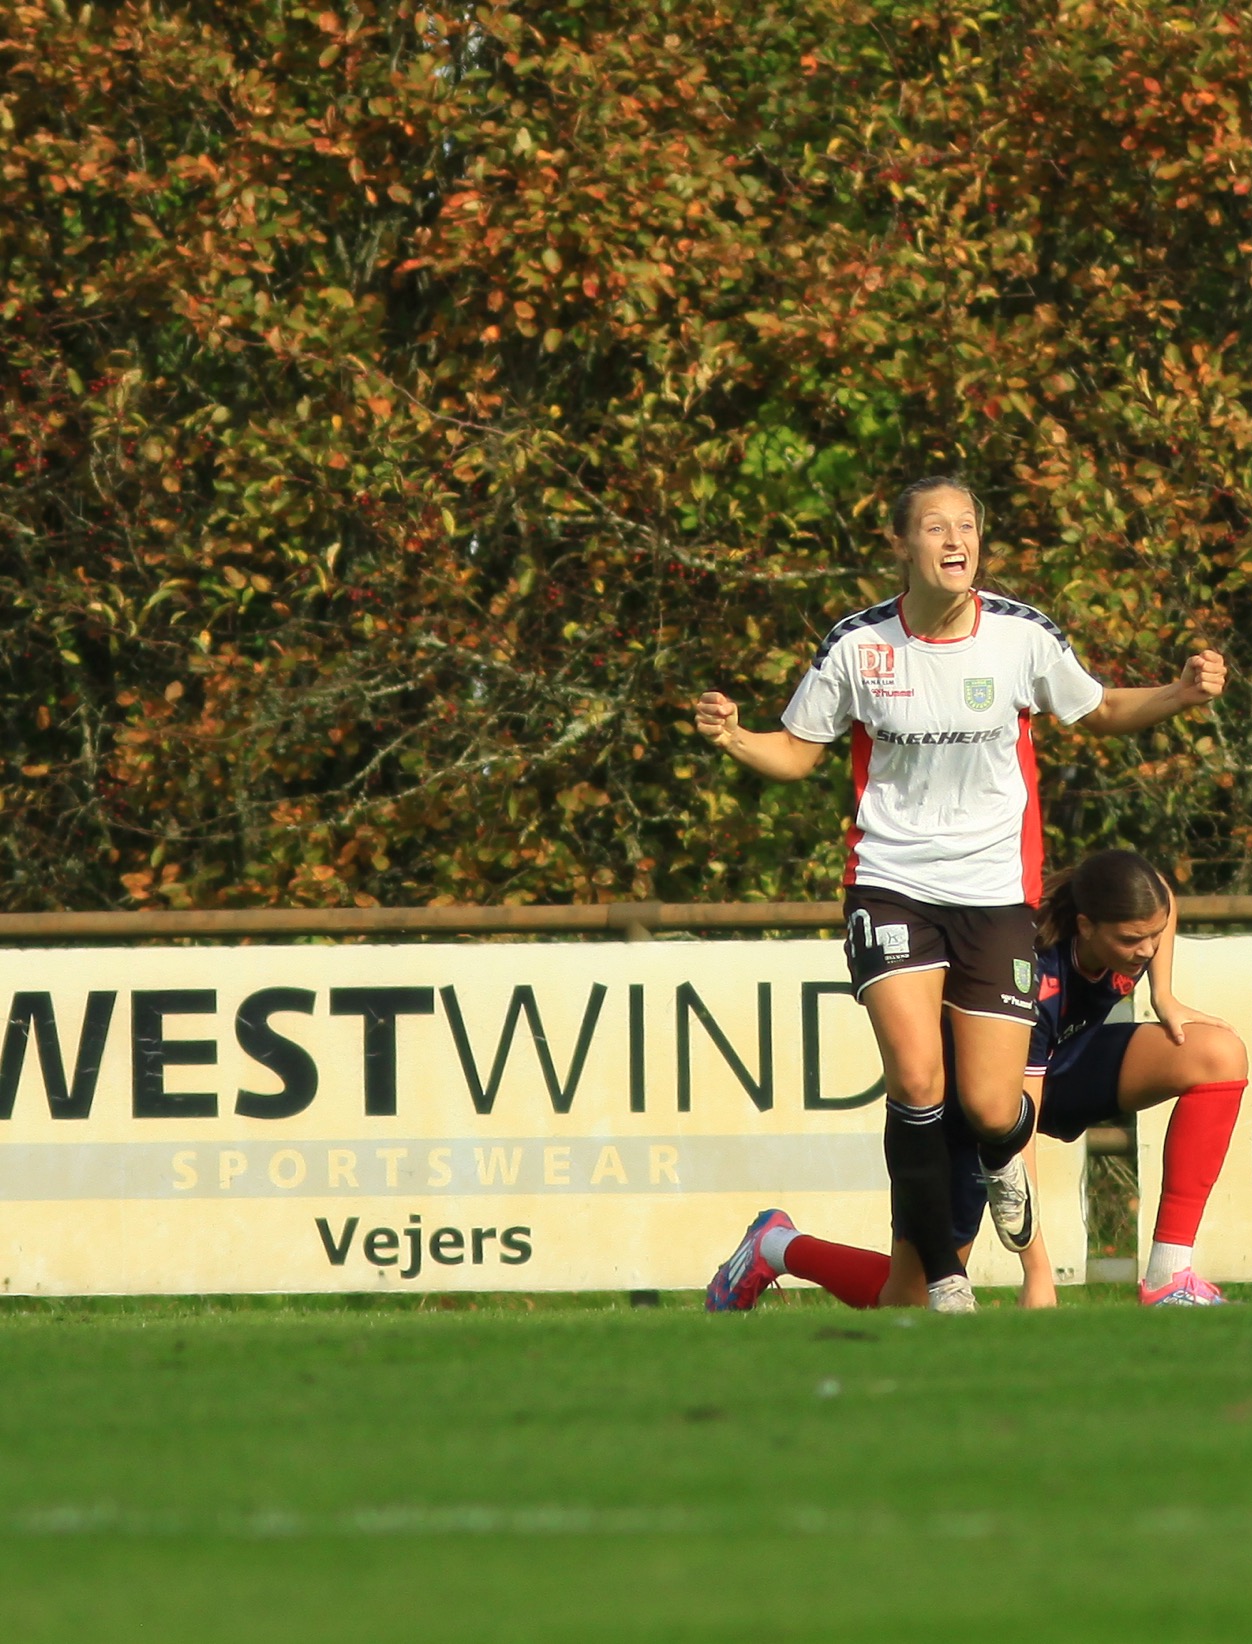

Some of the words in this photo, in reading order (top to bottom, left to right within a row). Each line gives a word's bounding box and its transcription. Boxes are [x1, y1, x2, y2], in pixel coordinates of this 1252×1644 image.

[876, 725, 1003, 745] SKECHERS
[172, 1144, 682, 1190] SPORTSWEAR
[315, 1215, 534, 1279] Vejers
